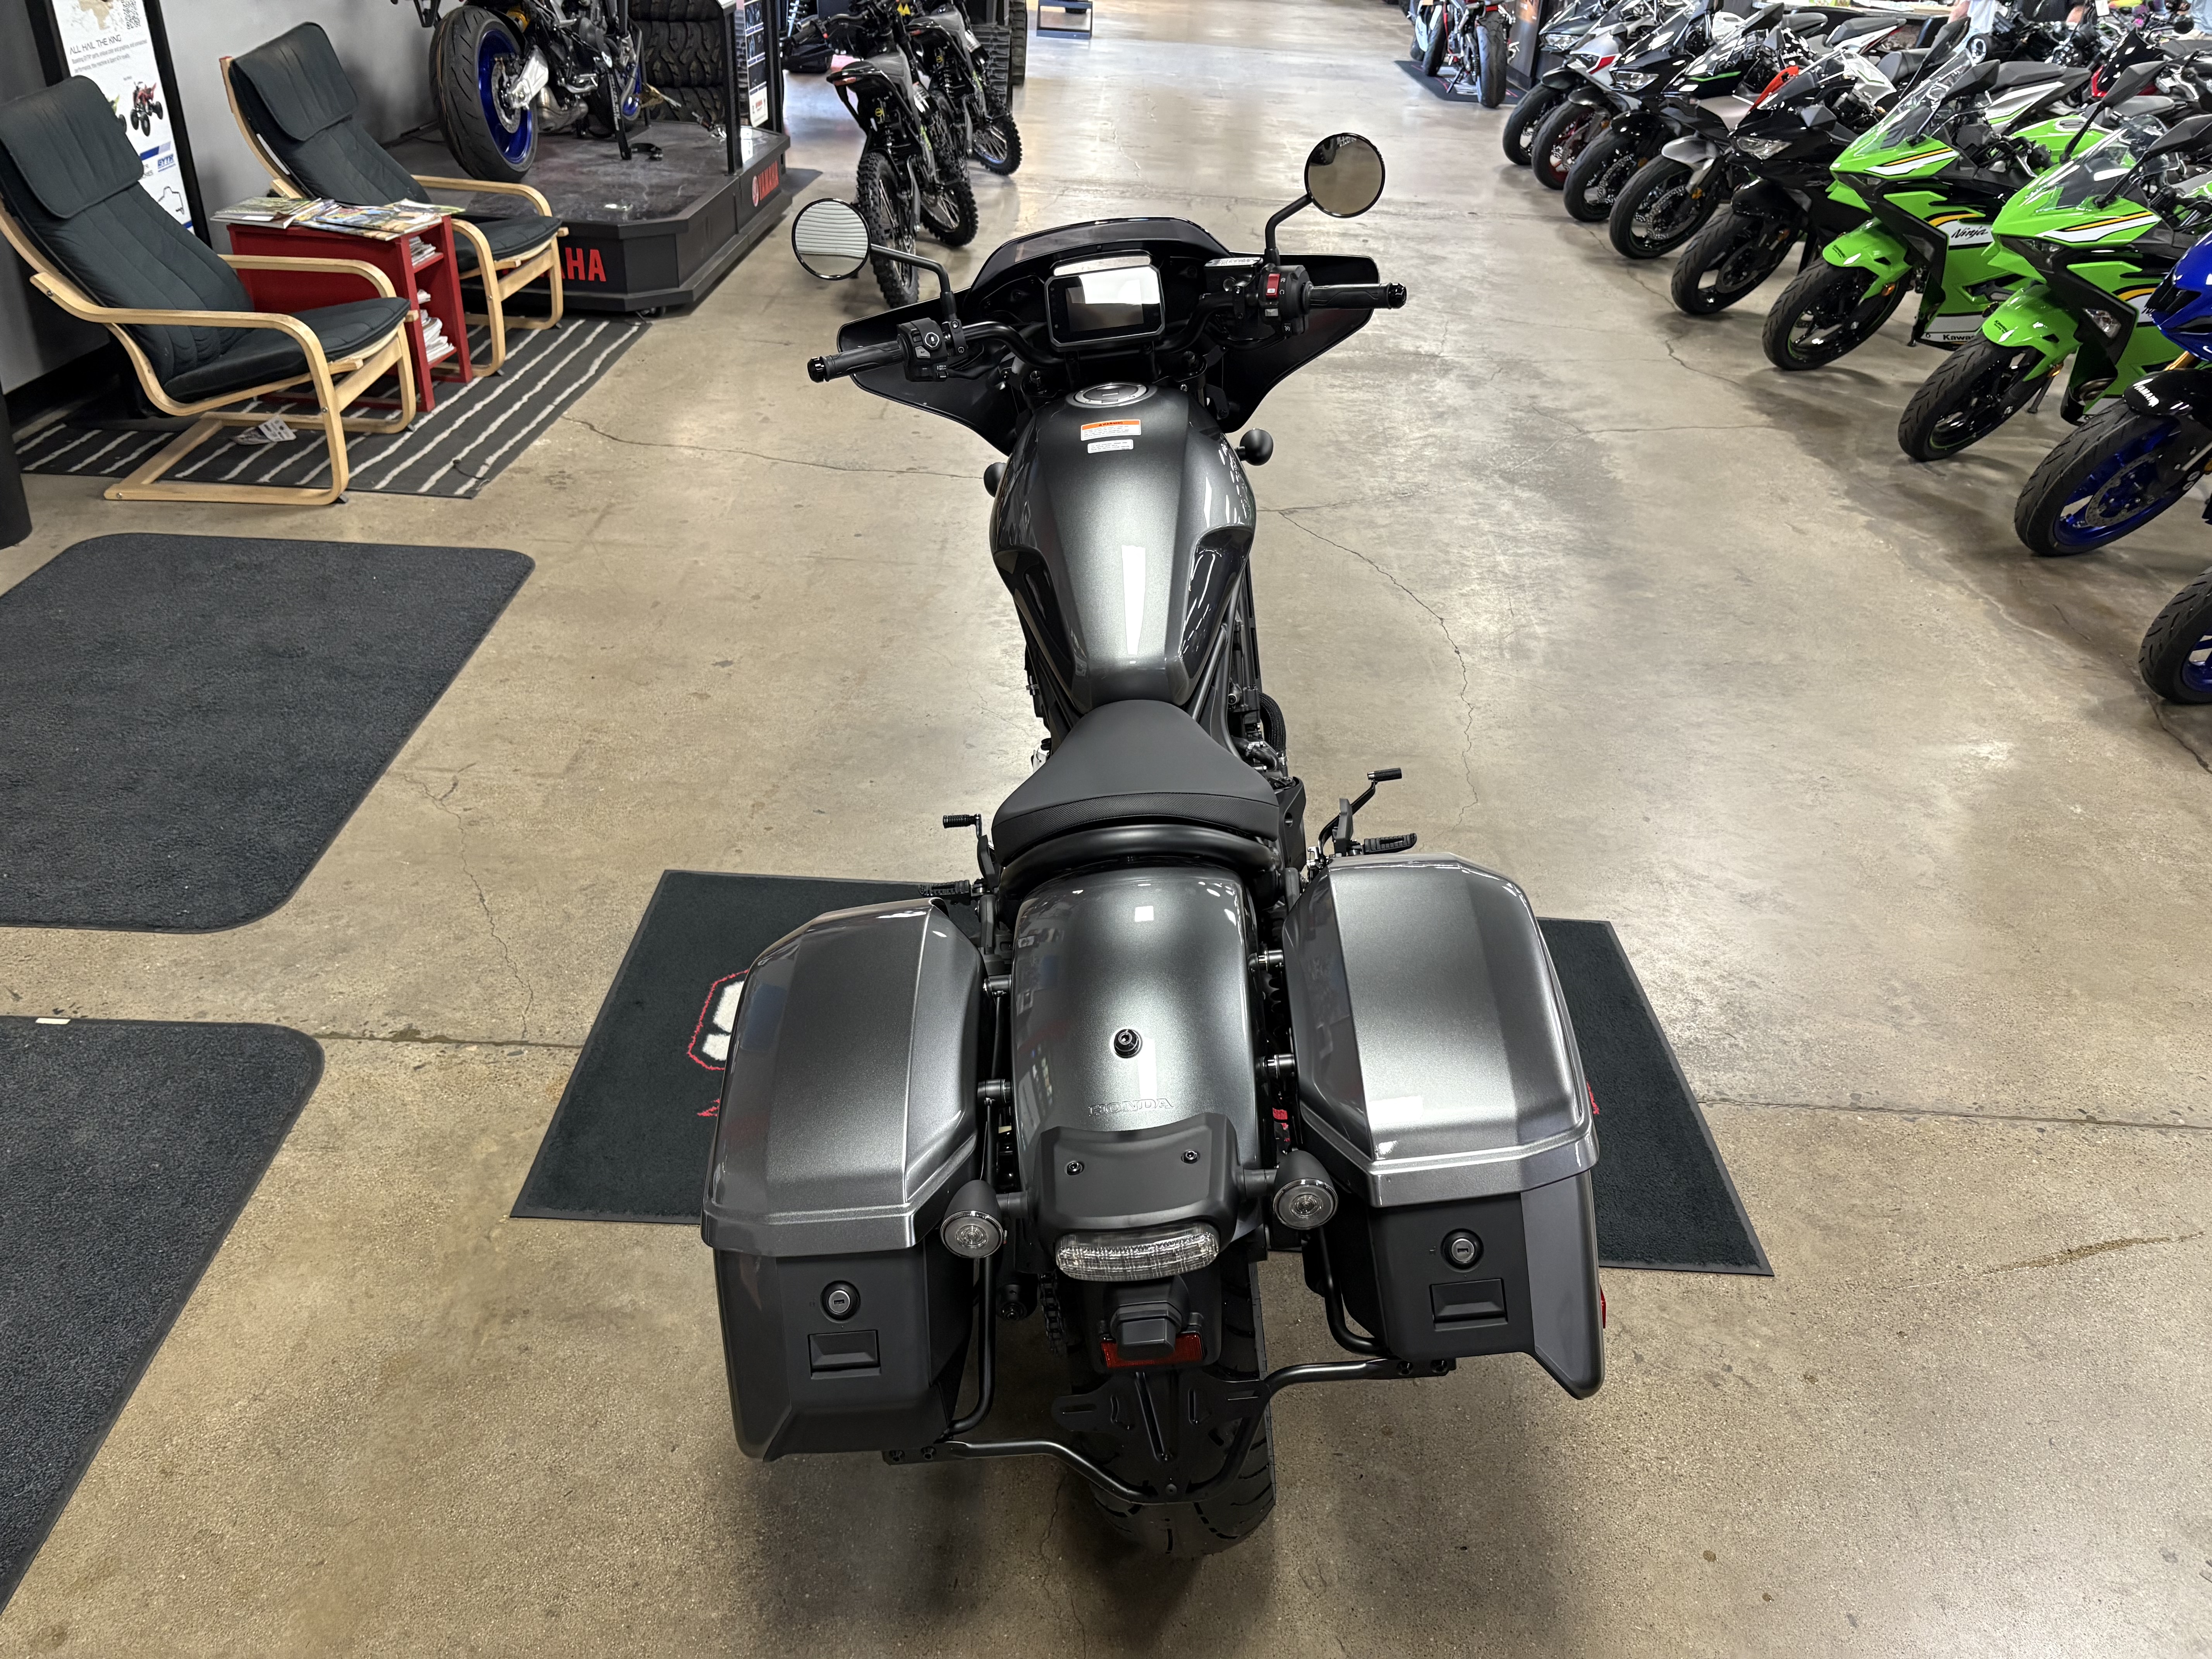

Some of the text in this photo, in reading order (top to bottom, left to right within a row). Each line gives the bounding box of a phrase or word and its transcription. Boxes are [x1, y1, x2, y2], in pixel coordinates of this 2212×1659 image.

[70, 34, 122, 55] ALL HAIL THE KING
[1951, 226, 1989, 240] Ninja
[1089, 1098, 1174, 1116] HONDA
